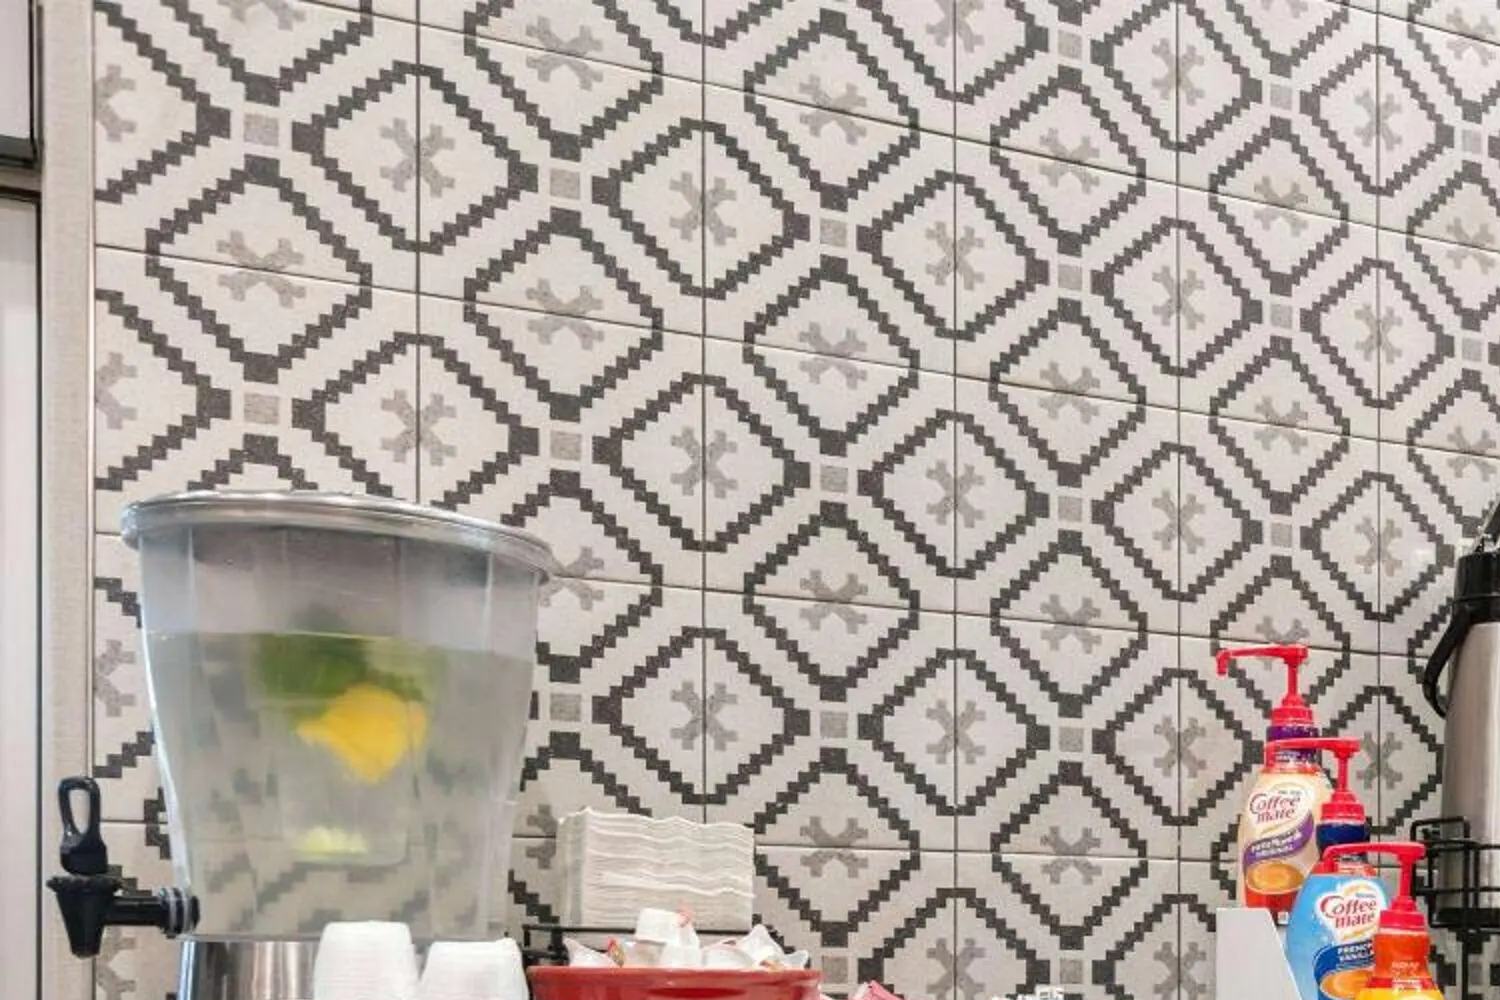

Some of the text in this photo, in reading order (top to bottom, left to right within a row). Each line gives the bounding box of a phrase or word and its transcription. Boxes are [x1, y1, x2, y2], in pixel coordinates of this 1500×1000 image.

[1249, 793, 1301, 814] Coffee
[1256, 808, 1296, 823] mate
[1320, 895, 1377, 918] Coffee
[1335, 912, 1375, 928] mate
